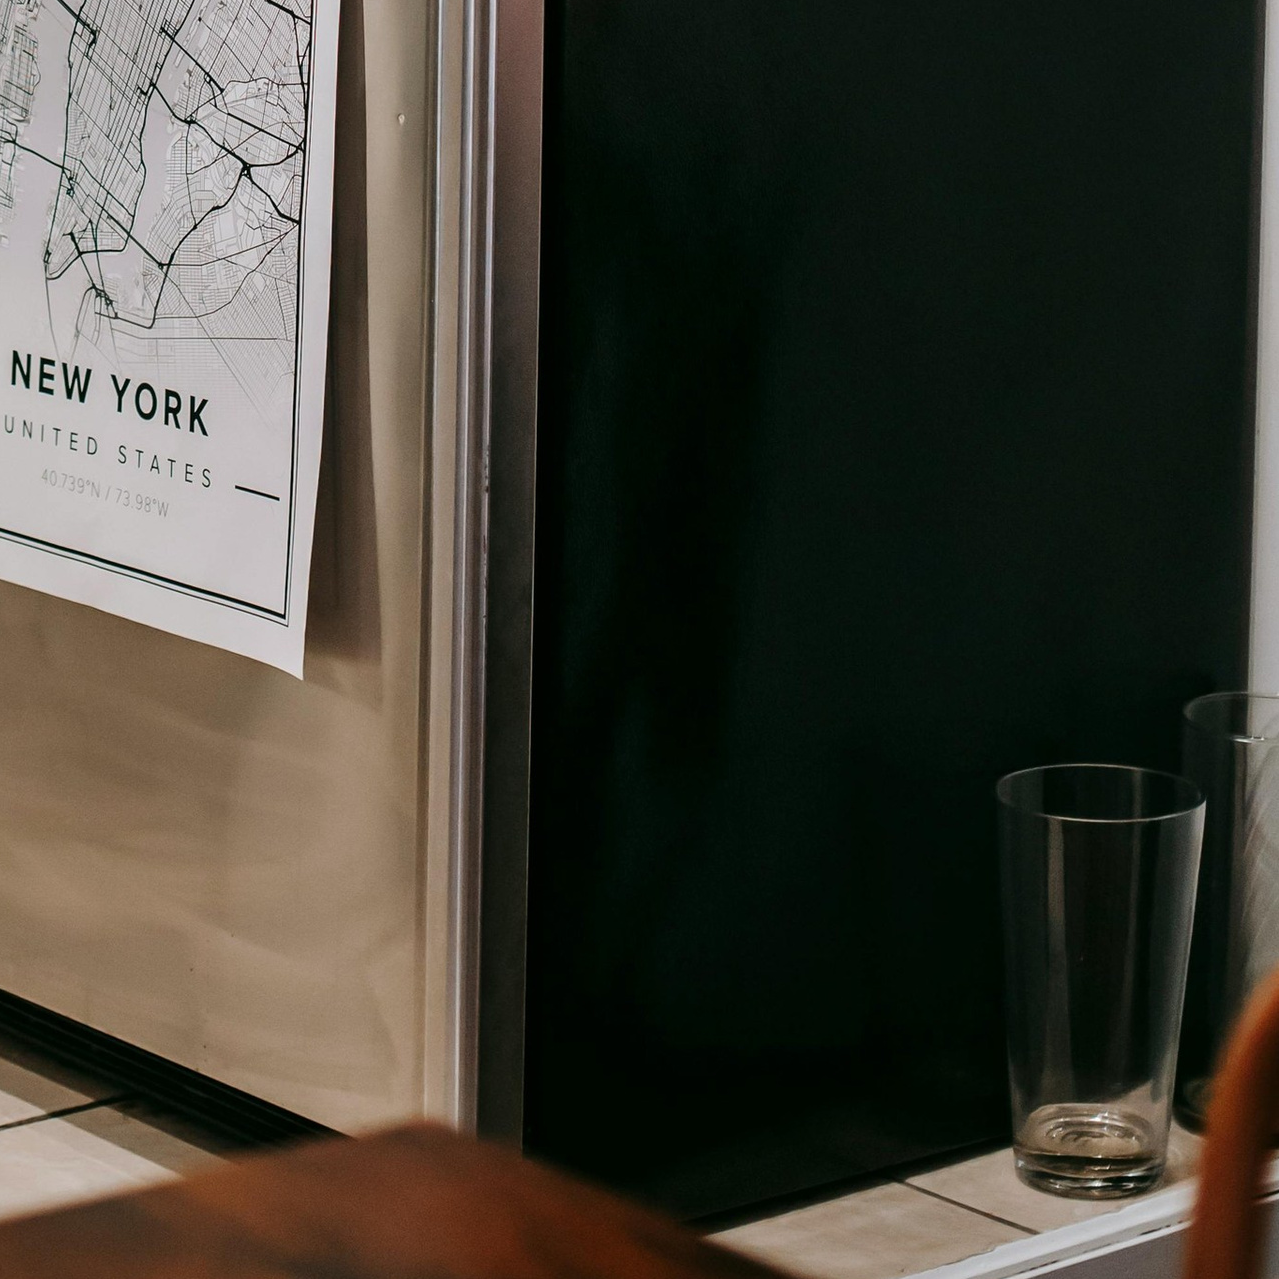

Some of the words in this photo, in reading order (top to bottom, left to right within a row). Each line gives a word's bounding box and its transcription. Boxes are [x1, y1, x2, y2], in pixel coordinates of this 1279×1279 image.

[11, 349, 92, 403] NEW
[110, 373, 209, 437] YORK
[4, 414, 98, 455] UNITED
[117, 444, 212, 488] STATES
